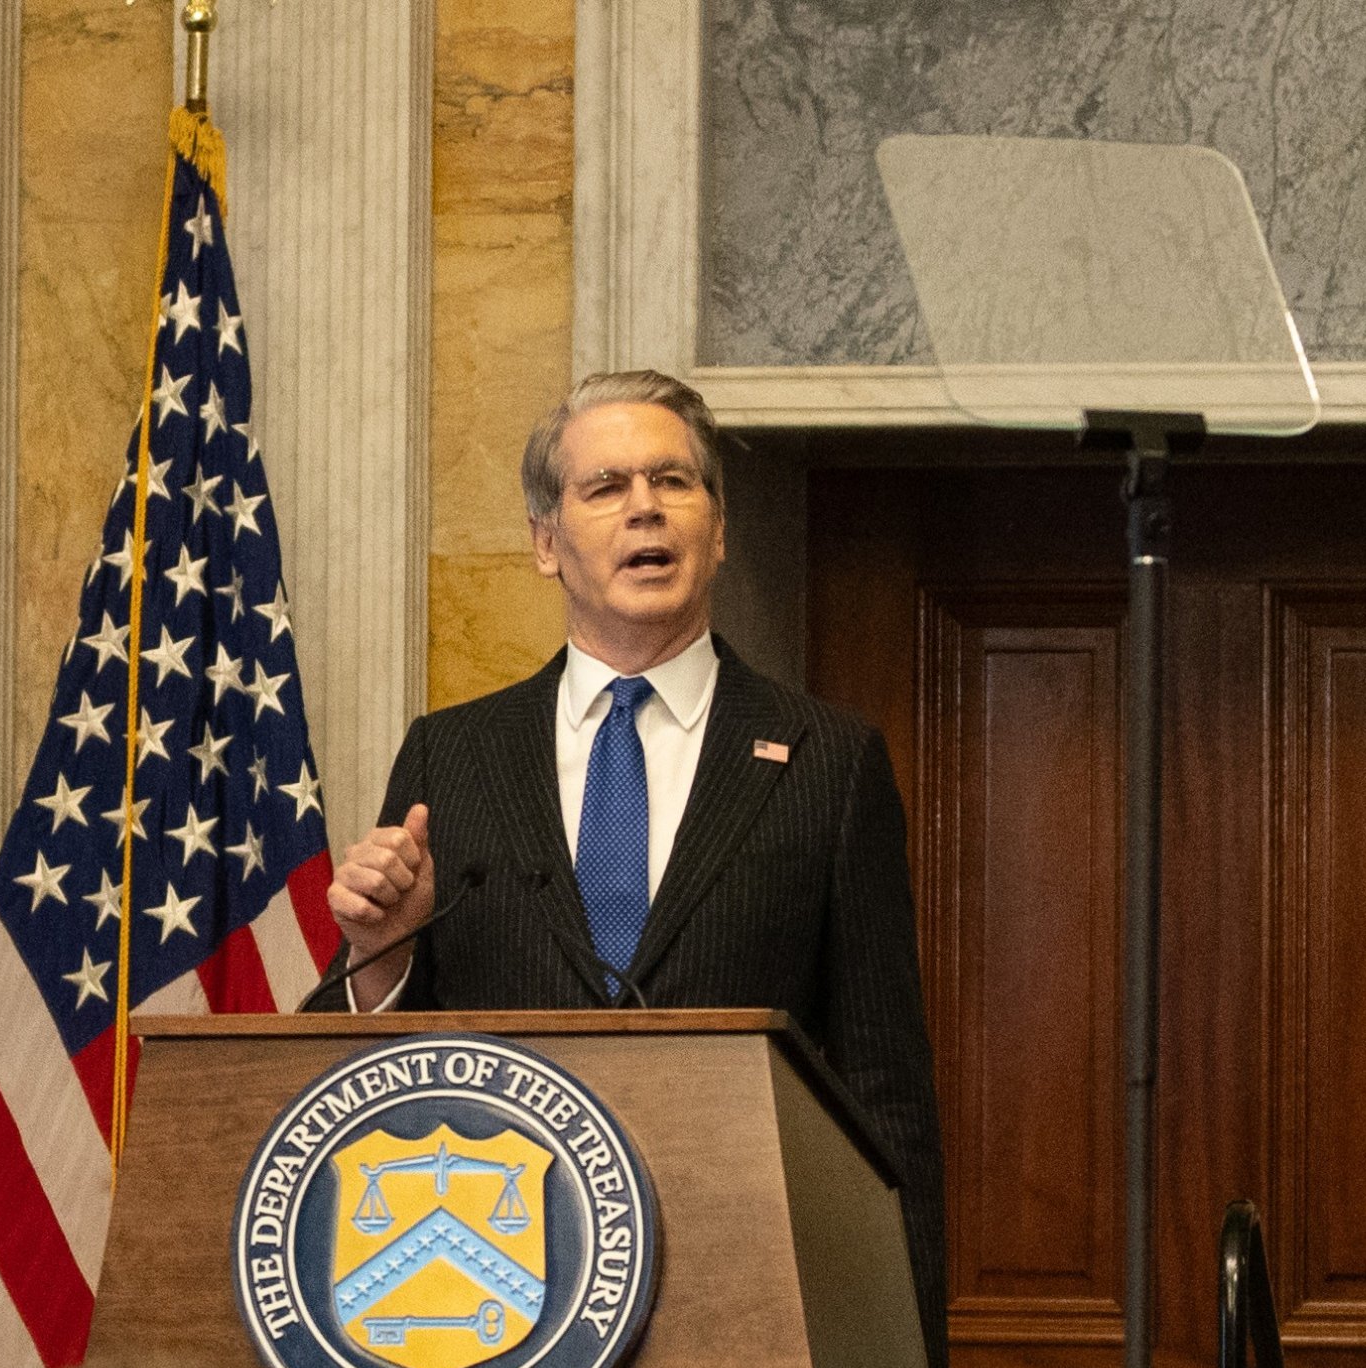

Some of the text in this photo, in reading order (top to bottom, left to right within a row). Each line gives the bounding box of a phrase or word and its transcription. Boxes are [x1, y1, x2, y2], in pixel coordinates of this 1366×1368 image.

[251, 1052, 633, 1341] THE DEPARTMENT OF THE TREASURY
